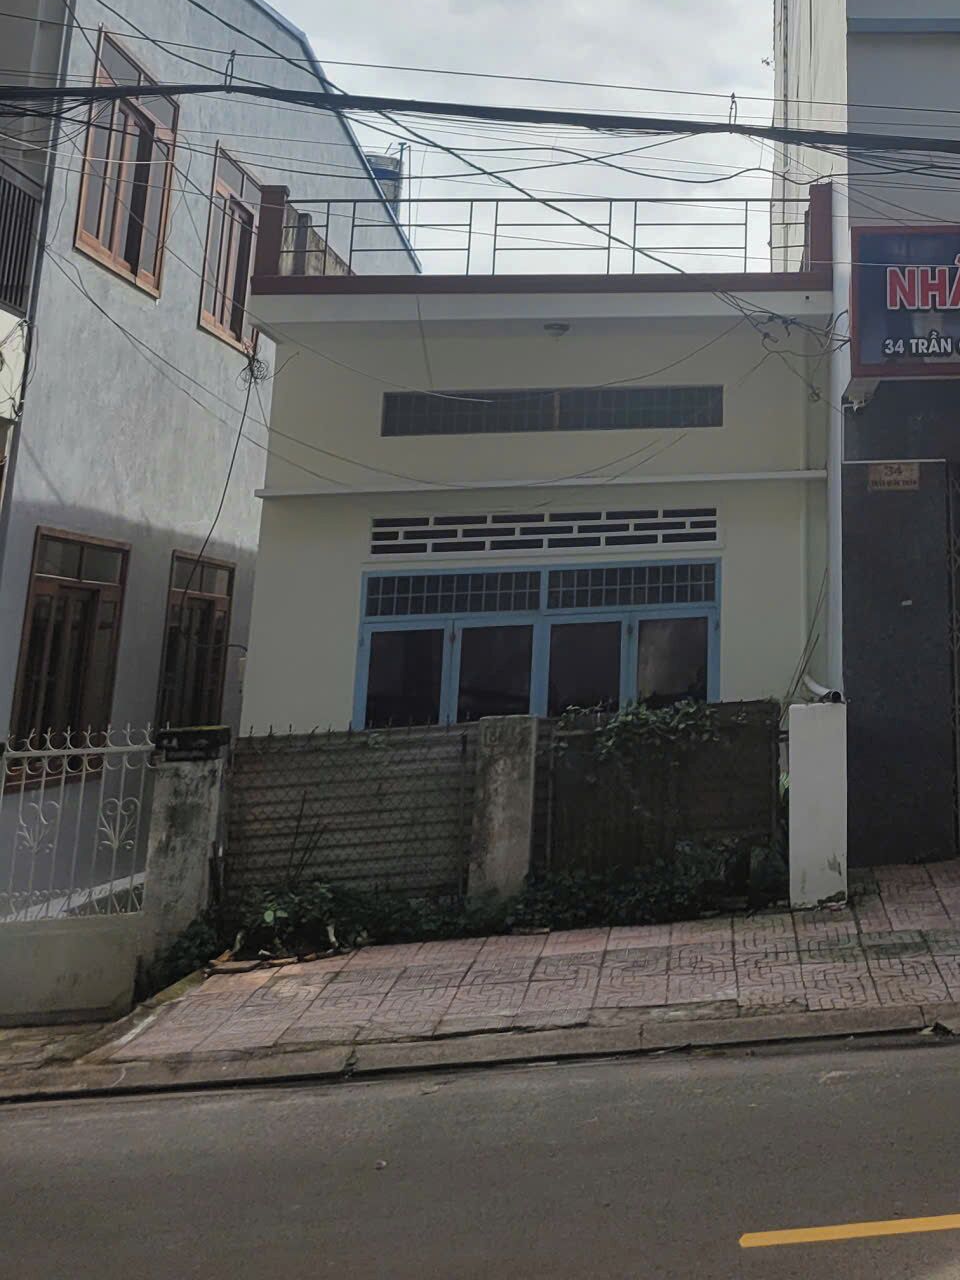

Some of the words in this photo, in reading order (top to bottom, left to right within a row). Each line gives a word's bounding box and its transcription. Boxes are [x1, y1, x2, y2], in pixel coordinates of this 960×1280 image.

[884, 338, 905, 354] 34
[910, 330, 952, 354] TRẦN
[883, 464, 904, 477] 34
